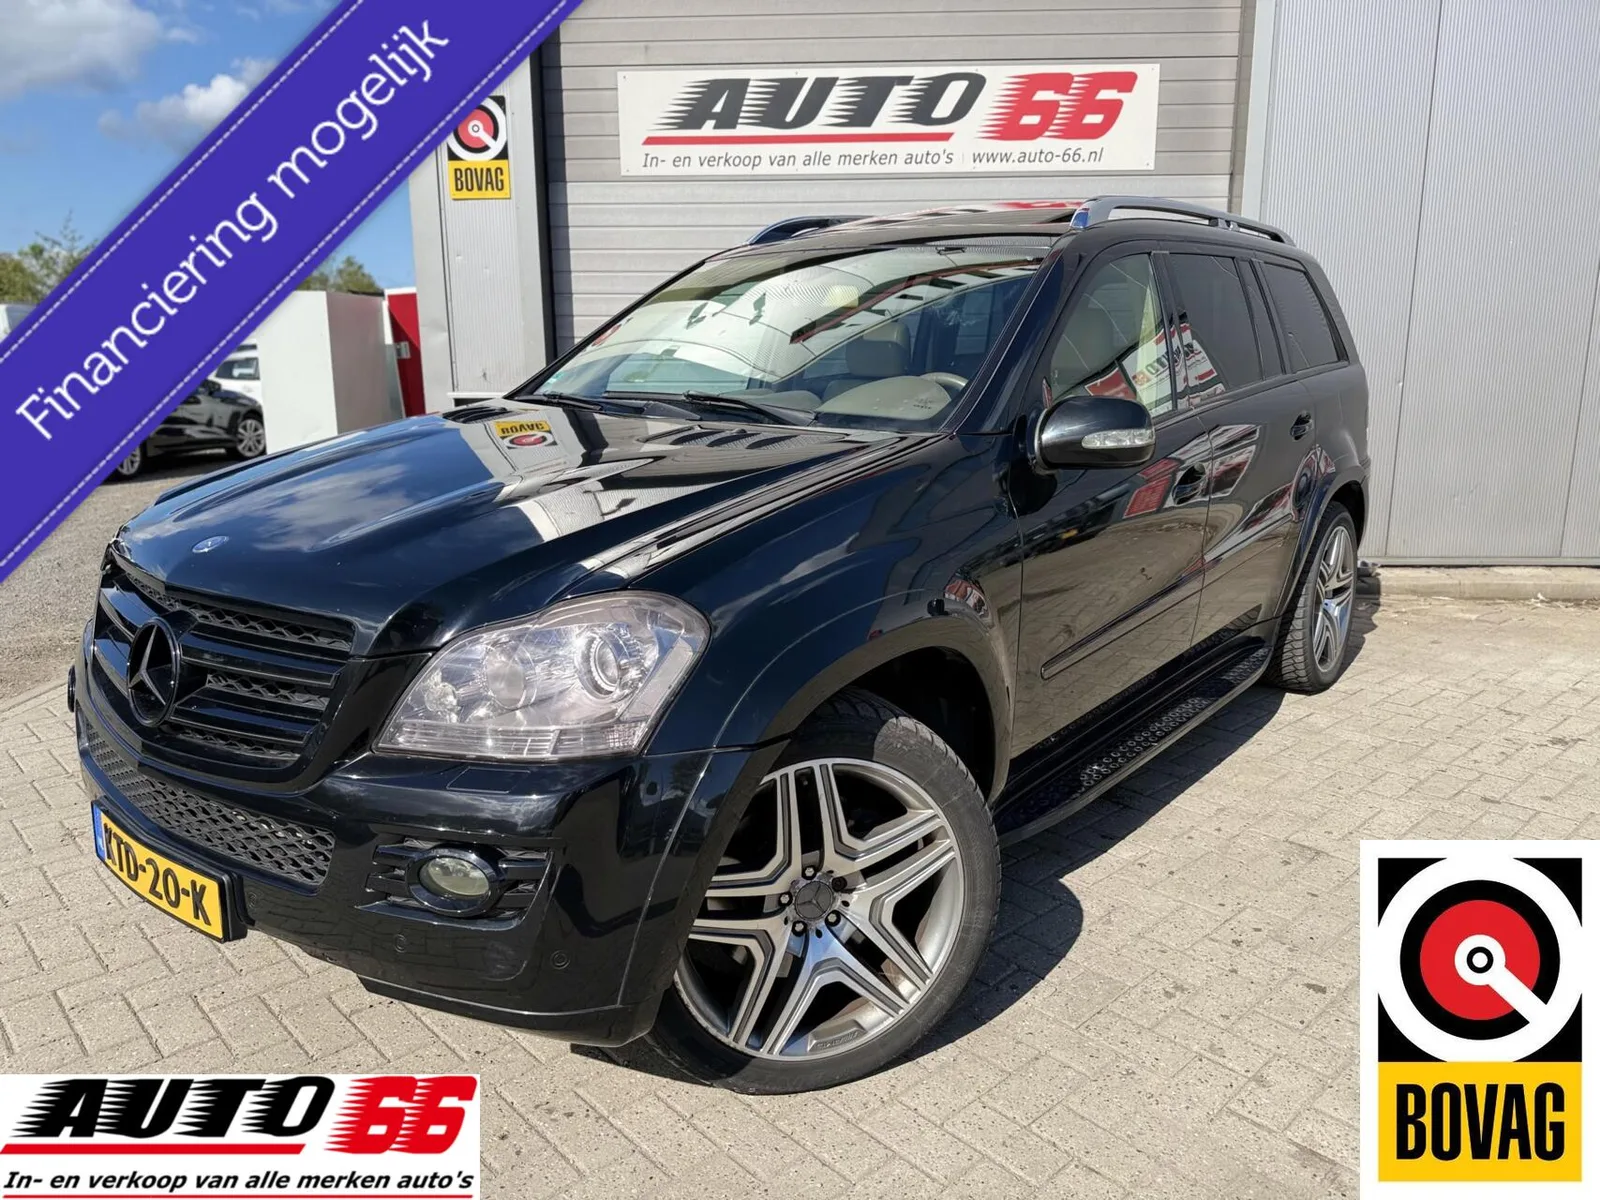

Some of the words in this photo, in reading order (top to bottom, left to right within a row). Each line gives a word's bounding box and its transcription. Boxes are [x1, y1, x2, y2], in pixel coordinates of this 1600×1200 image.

[647, 71, 987, 130] AUTO
[975, 71, 1138, 141] 66
[454, 167, 504, 192] BOVAG
[642, 153, 666, 168] In-
[672, 155, 692, 167] en
[699, 152, 762, 170] verkoop
[769, 153, 796, 167] van
[802, 151, 830, 166] alle
[838, 150, 898, 166] merken
[904, 149, 954, 165] auto's
[972, 147, 1104, 164] www.auto-66.nl
[103, 822, 212, 927] KTD-20-K
